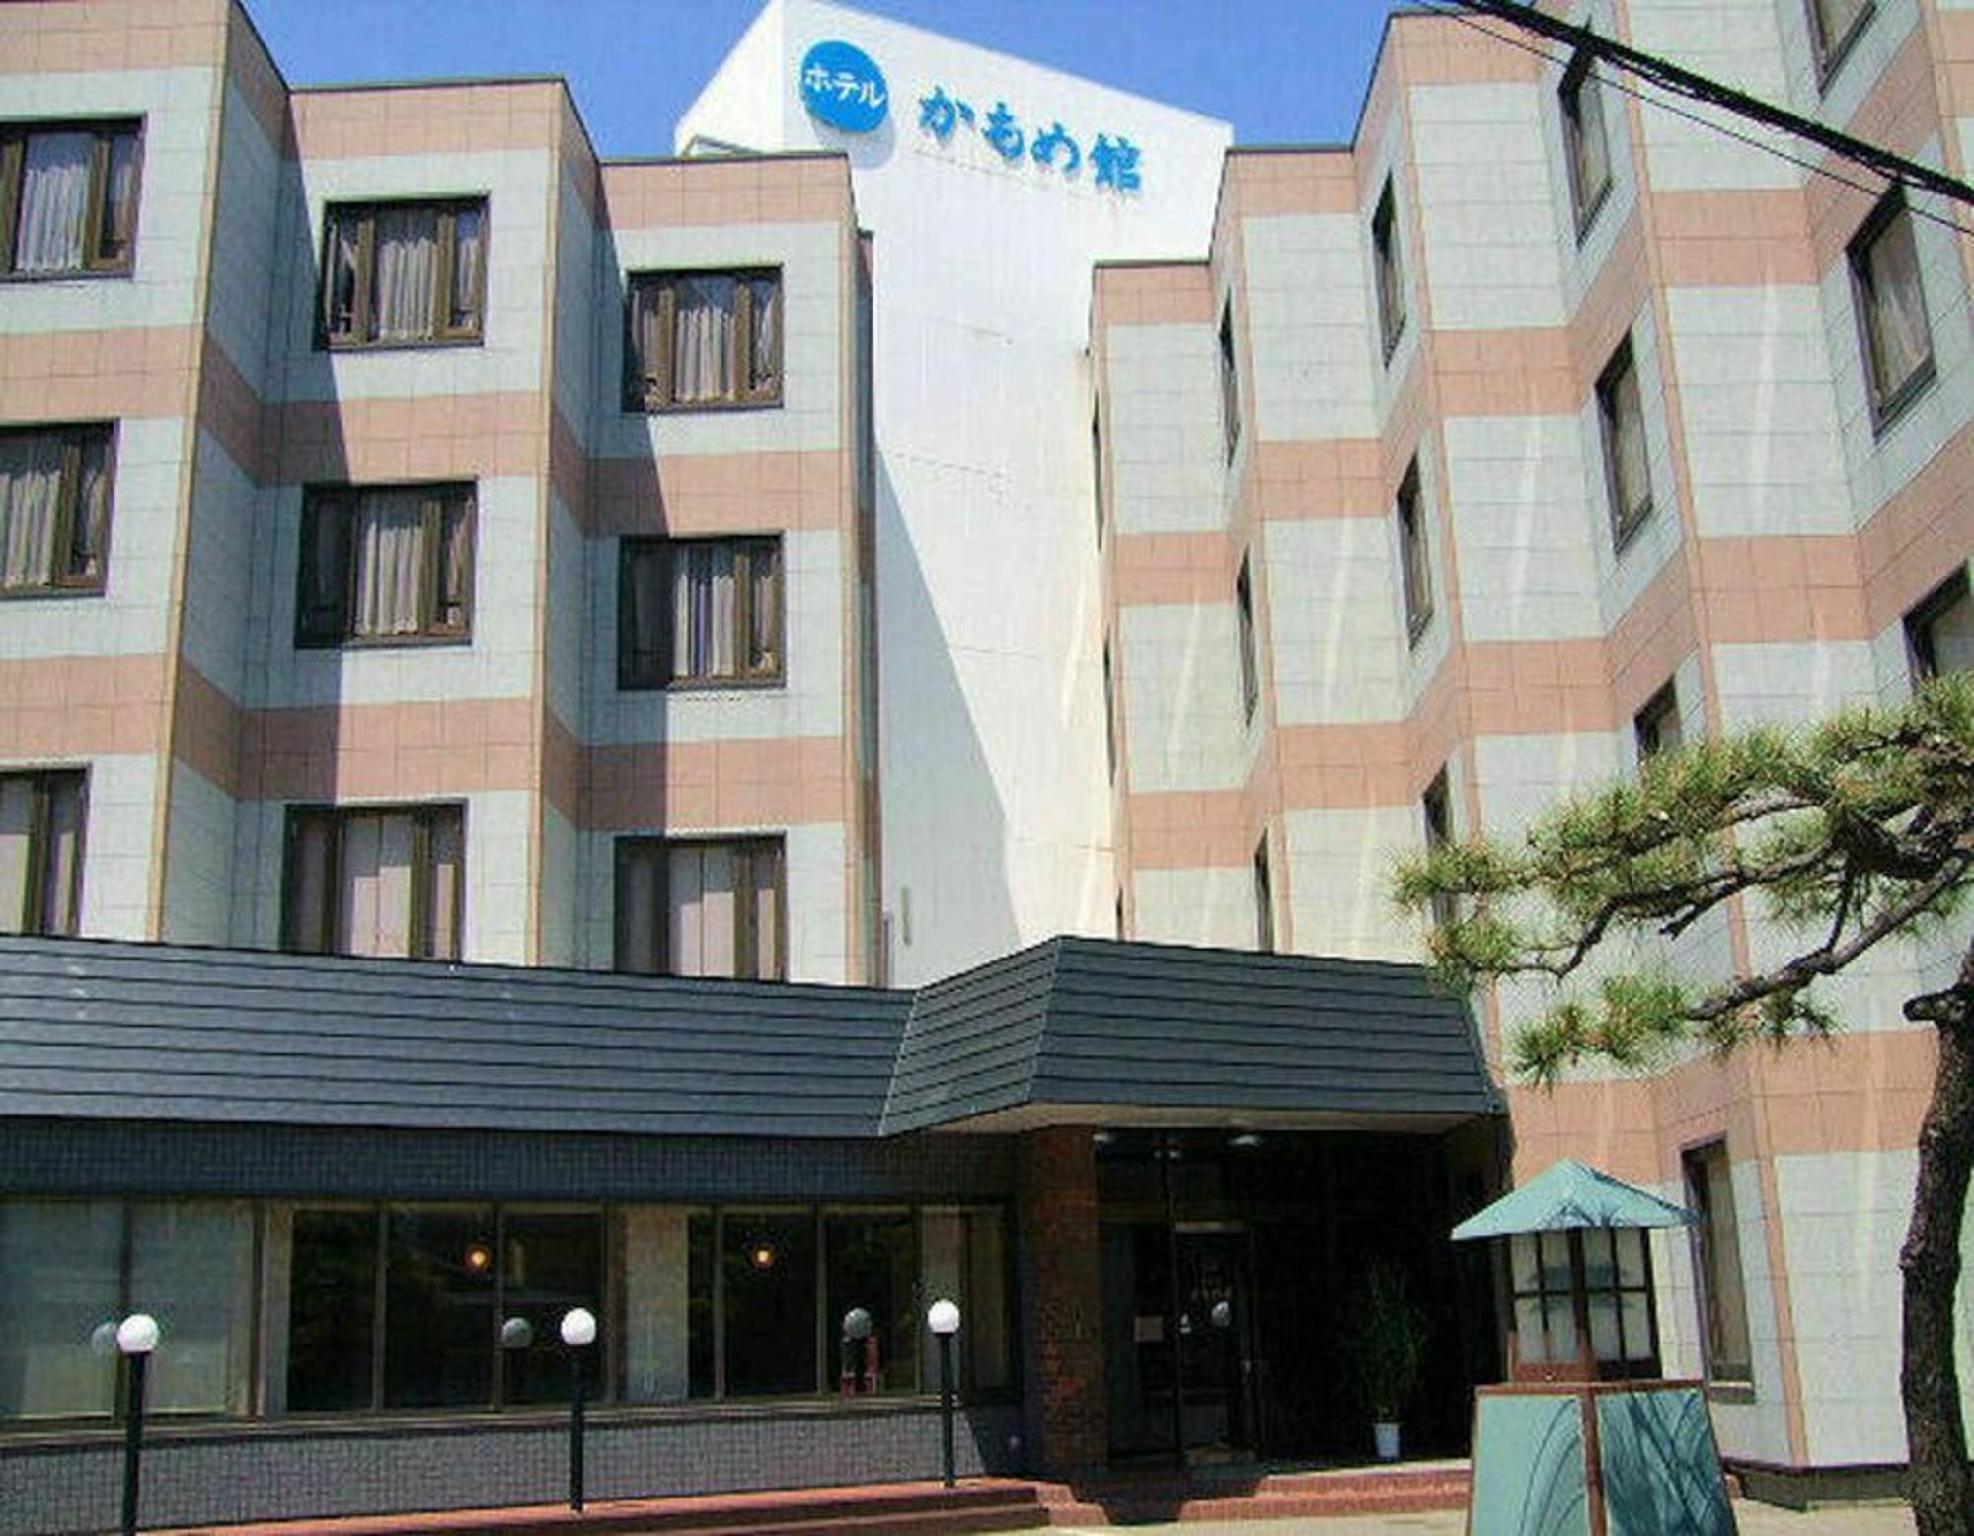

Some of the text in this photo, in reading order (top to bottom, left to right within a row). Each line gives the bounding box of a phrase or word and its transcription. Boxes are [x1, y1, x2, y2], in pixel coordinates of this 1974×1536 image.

[803, 62, 885, 108] ホテル
[918, 86, 1142, 191] かもめ館
